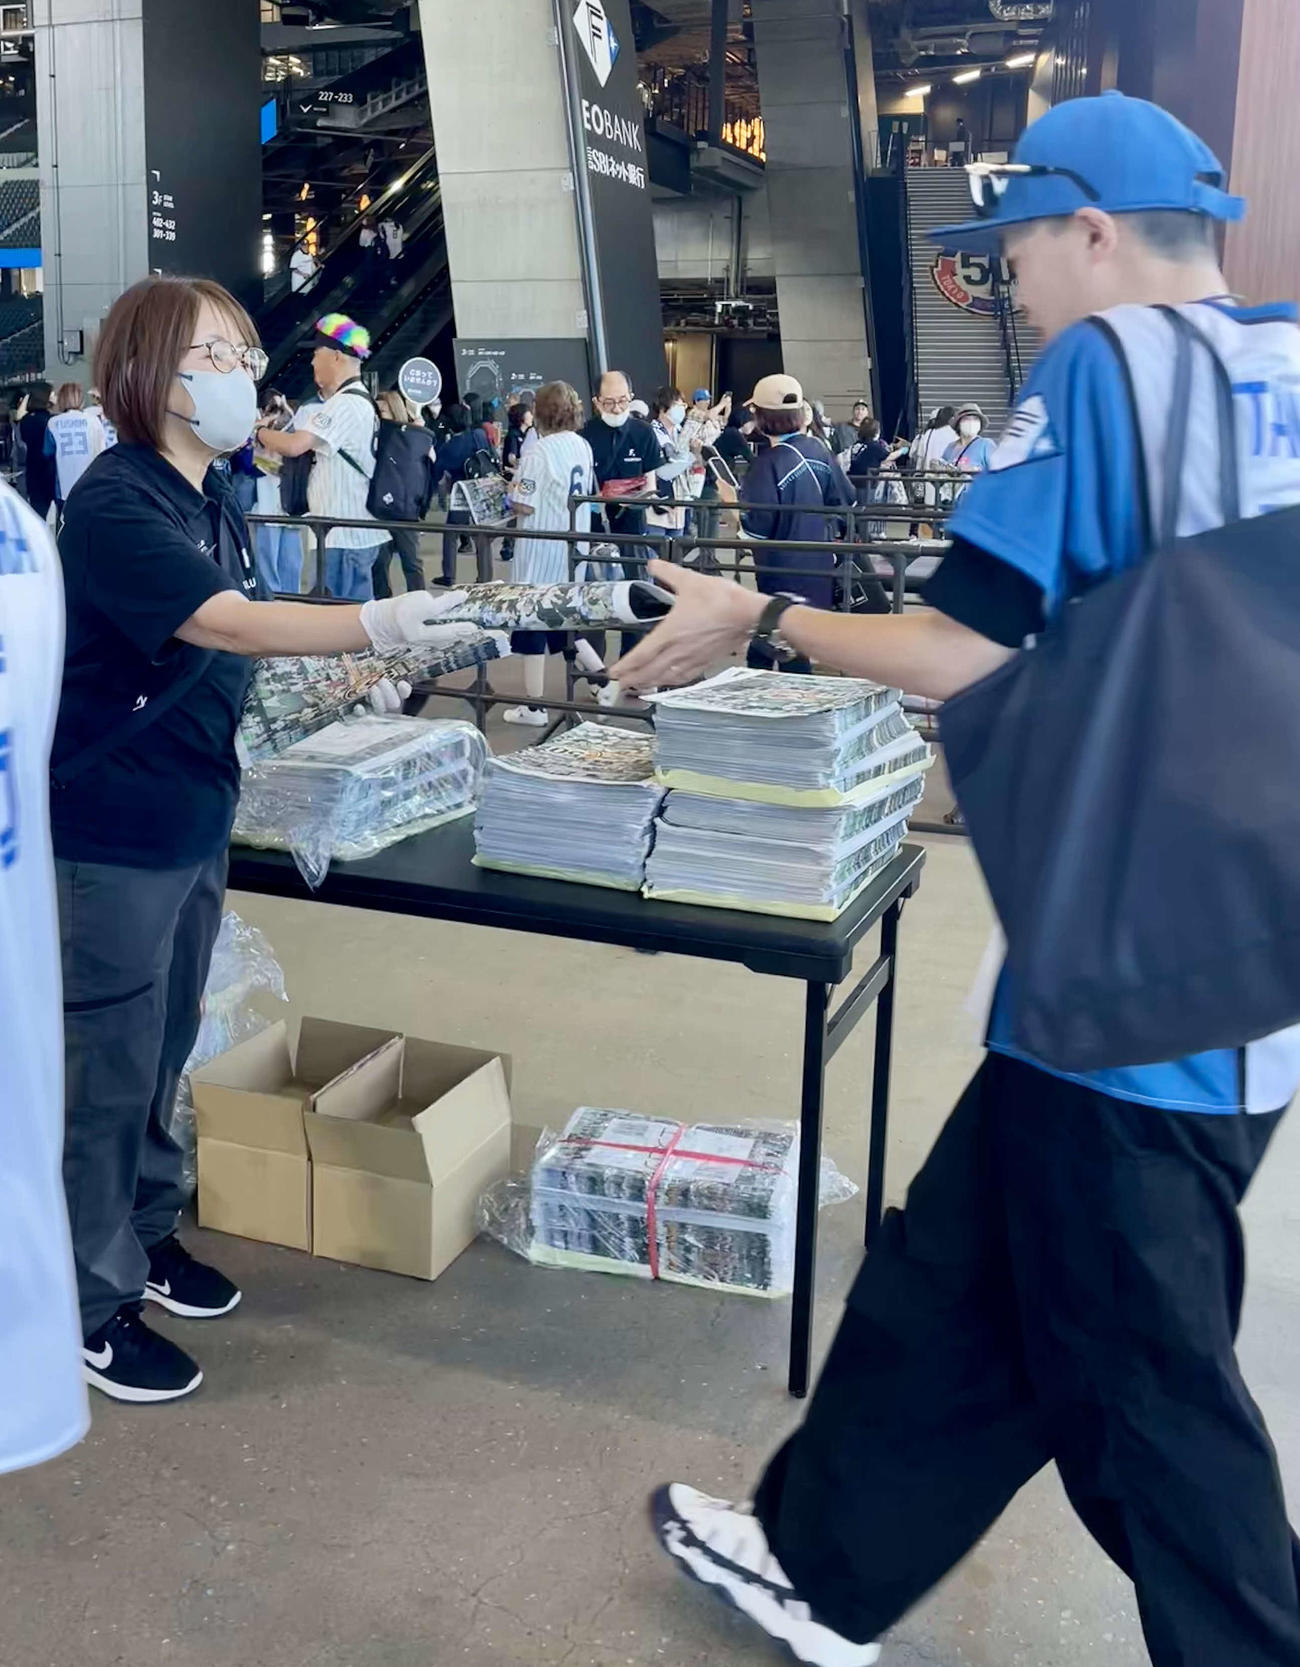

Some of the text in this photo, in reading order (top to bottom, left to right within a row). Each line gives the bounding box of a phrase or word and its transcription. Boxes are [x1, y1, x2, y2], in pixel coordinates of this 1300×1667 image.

[318, 91, 353, 103] 227-233
[581, 98, 642, 153] EOBANK
[60, 432, 89, 456] 23
